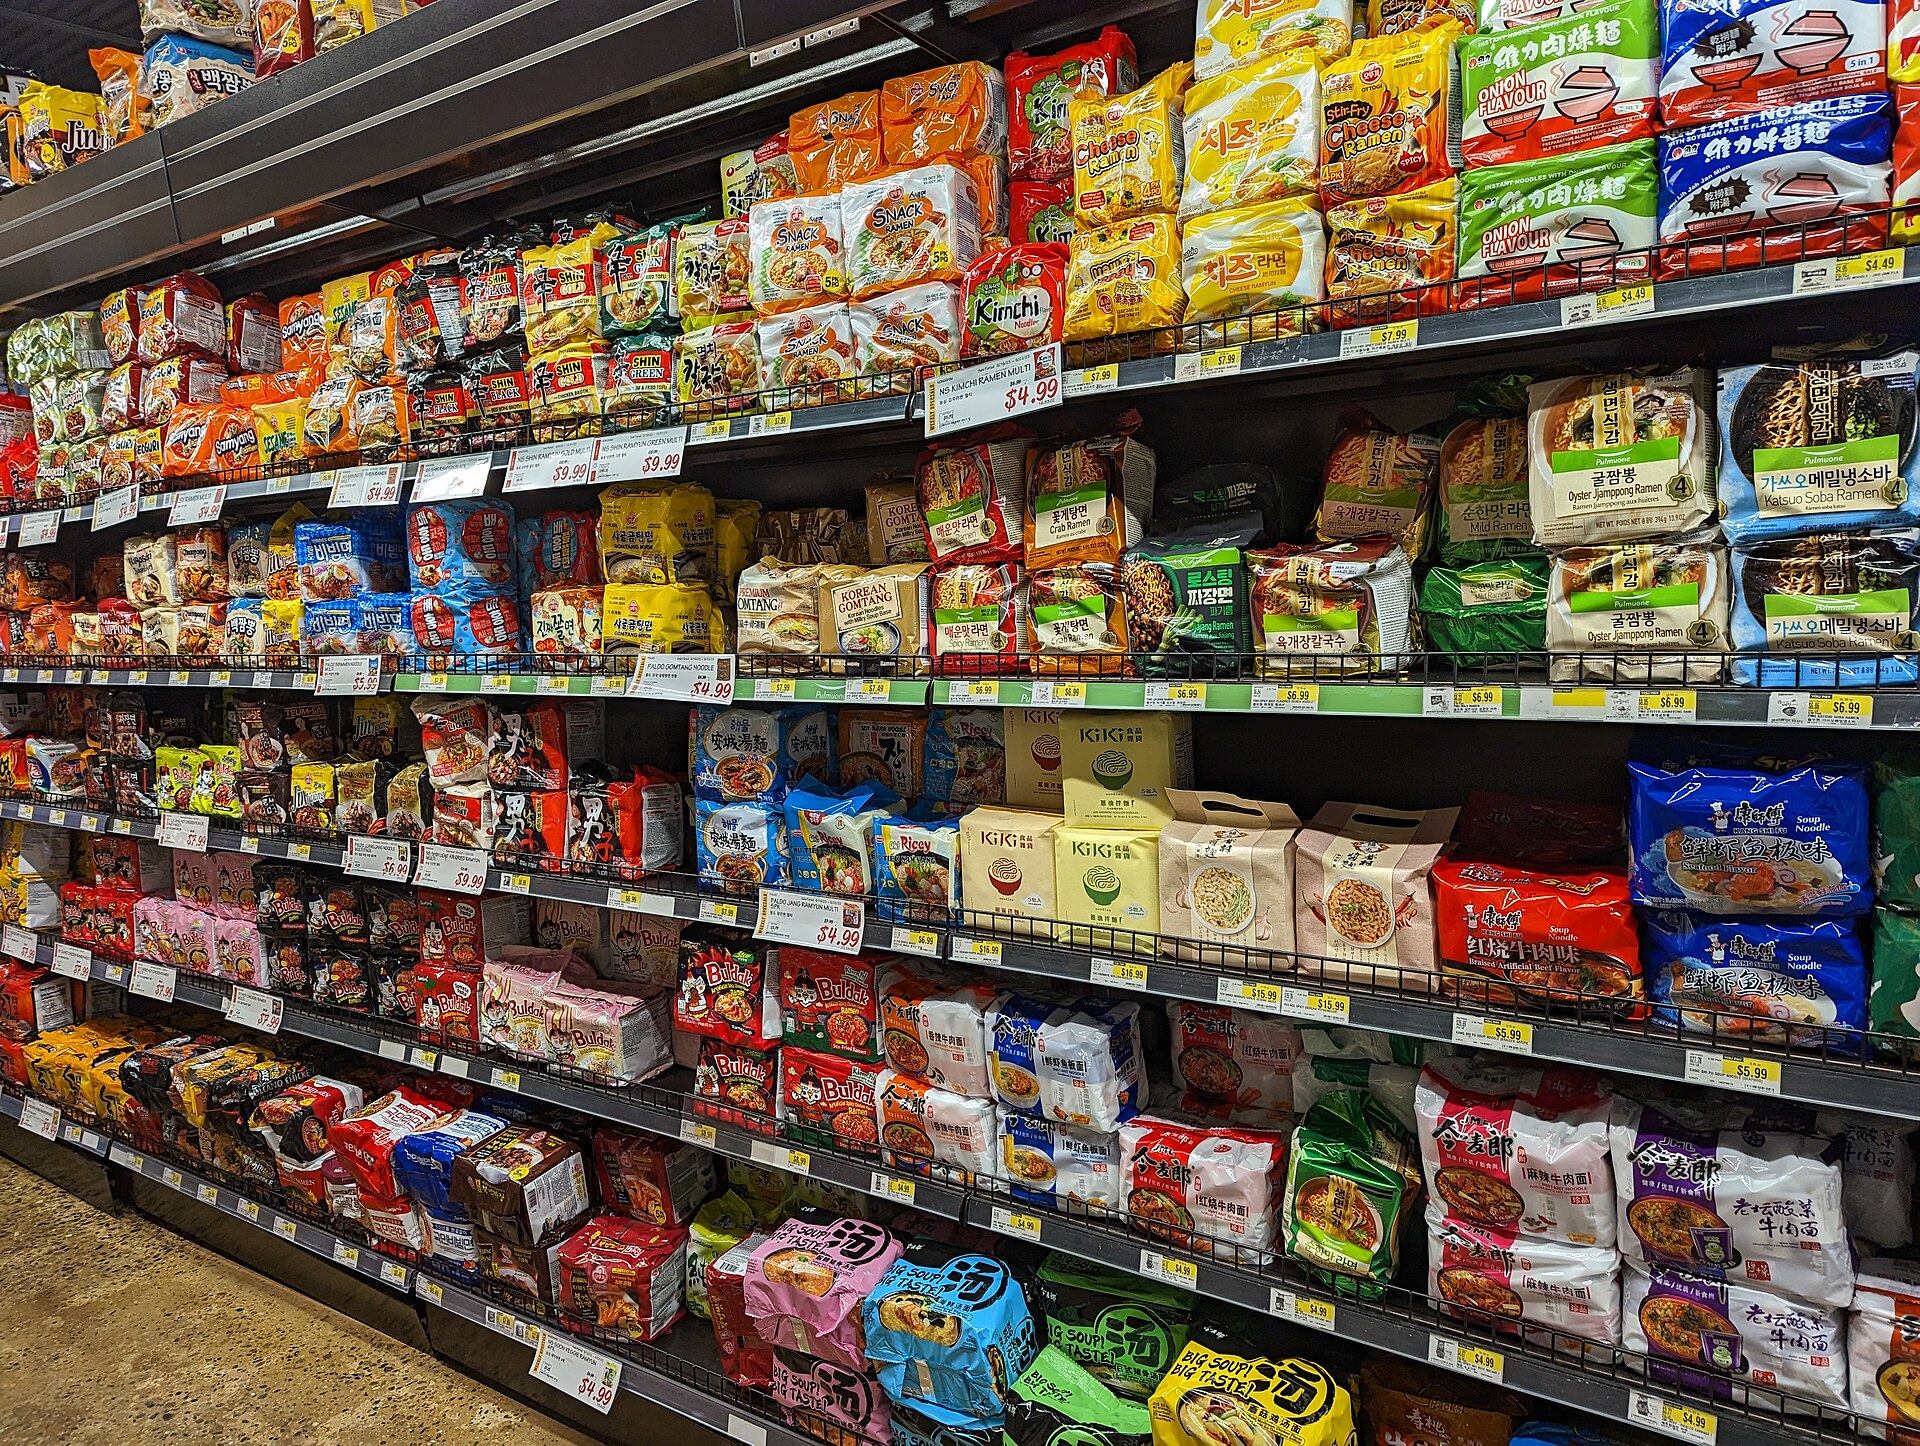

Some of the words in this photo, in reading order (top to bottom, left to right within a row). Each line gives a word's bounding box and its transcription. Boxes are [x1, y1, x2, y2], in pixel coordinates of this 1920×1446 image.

[1478, 69, 1528, 102] ONION
[1479, 83, 1547, 117] FLAVOUR
[1200, 119, 1259, 154] 치즈
[1327, 113, 1404, 151] Cheese
[1076, 129, 1138, 164] Cheese
[1344, 129, 1404, 160] Ramen
[1088, 146, 1138, 176] Ramen
[1400, 156, 1423, 168] SPICY
[873, 203, 923, 227] SNACK
[778, 226, 818, 245] SNACK
[886, 221, 914, 233] RAMEN
[1481, 219, 1530, 246] ONION
[787, 242, 810, 252] RAMEN
[1481, 230, 1550, 259] FLAVOUR
[1204, 253, 1257, 288] 치즈
[1257, 251, 1287, 269] 라면
[1347, 256, 1406, 278] Ramen
[1865, 256, 1894, 271] $4.49
[1229, 284, 1257, 294] CHEESE
[1258, 280, 1277, 290] RAMYUN
[1622, 286, 1646, 302] $4.49
[975, 296, 1040, 327] Kimchi
[1381, 328, 1407, 342] $7.99
[633, 355, 662, 368] SHIN
[793, 347, 819, 358] RAMEN
[1217, 355, 1236, 366] $7.99
[556, 360, 582, 376] SHIN
[630, 367, 664, 379] GREEN
[491, 377, 514, 389] SHIN
[939, 385, 950, 396] NS
[951, 376, 976, 393] KIMCHI
[977, 369, 1008, 387] RAMEN
[1008, 362, 1032, 379] MULTI
[434, 392, 456, 404] SHIN
[491, 387, 519, 401] BLACK
[1005, 378, 1058, 411] $4.99
[1602, 378, 1620, 446] 생면식감
[1810, 370, 1835, 439] 생면식감
[643, 453, 680, 472] $9.99
[1591, 467, 1637, 488] 굴짬뽕
[1761, 467, 1892, 491] 가쓰오메밀냉소바
[367, 487, 396, 501] $4.99
[1568, 489, 1593, 504] Oyster
[1635, 483, 1662, 496] Ramen
[1764, 490, 1802, 507] Katsuo
[1804, 488, 1836, 505] Soba
[1838, 486, 1879, 502] Ramen
[1051, 505, 1088, 525] 꽃게탕면
[1050, 523, 1064, 535] Crab
[1065, 518, 1091, 531] Ramen
[1470, 520, 1491, 533] Mild
[1493, 520, 1528, 532] Ramen
[1187, 568, 1233, 586] 로스팅
[841, 583, 887, 601] KOREAN
[1187, 587, 1233, 605] 짜장면
[838, 592, 893, 614] GOMTANG
[971, 622, 989, 635] 라면
[1610, 612, 1656, 631] 굴짬뽕
[1773, 619, 1903, 638] 가쓰오메밀냉소바
[1276, 633, 1346, 651] 육개장칼국수
[1587, 628, 1611, 642] Oyster
[1655, 625, 1683, 638] Ramen
[691, 682, 732, 698] $4.99
[975, 685, 992, 695] $6.99
[1177, 688, 1198, 698] $6.99
[1287, 690, 1310, 701] $6.99
[1472, 691, 1493, 702] $6.99
[1660, 697, 1685, 708] $6.99
[1832, 701, 1860, 714] $6.99
[1079, 728, 1124, 744] KiKi
[1795, 822, 1831, 833] Noodle
[1796, 814, 1821, 825] Soup
[980, 831, 1018, 848] KiKi
[1072, 841, 1112, 859] KiKi
[1681, 836, 1832, 862] 鲜虾鱼板味
[1682, 861, 1722, 873] Seafood
[1723, 862, 1758, 875] Flavor
[455, 872, 484, 889] $9.99
[787, 899, 800, 907] JANG
[801, 901, 822, 909] RAMYUN
[823, 904, 839, 912] MULTI
[441, 917, 476, 934] Buldak
[1550, 925, 1570, 935] Soup
[817, 927, 860, 948] $4.99
[1548, 933, 1578, 942] Noodle
[979, 945, 999, 955] $16.99
[1467, 935, 1581, 963] 红烧牛肉味
[705, 962, 752, 985] Buldak
[1120, 967, 1144, 980] $16.99
[815, 977, 869, 1005] Buldak
[1251, 987, 1277, 1002] $15.99
[1317, 997, 1345, 1012] $15.99
[573, 1030, 616, 1050] Buldak
[1495, 1027, 1522, 1042] $5.99
[716, 1055, 766, 1080] Buldak
[1736, 1064, 1768, 1081] $5.99
[822, 1079, 875, 1106] Buldak
[1527, 1167, 1588, 1188] 麻辣牛肉面
[1759, 1217, 1819, 1238] 牛肉面
[1175, 1265, 1191, 1276] $4.99
[1310, 1305, 1327, 1317] $4.99
[1770, 1328, 1828, 1351] 牛肉面
[1181, 1350, 1207, 1367] BIG
[1208, 1356, 1252, 1379] SOUP!
[1171, 1363, 1197, 1381] BIG
[1199, 1370, 1255, 1399] TASTE!
[578, 1377, 613, 1406] $4.99
